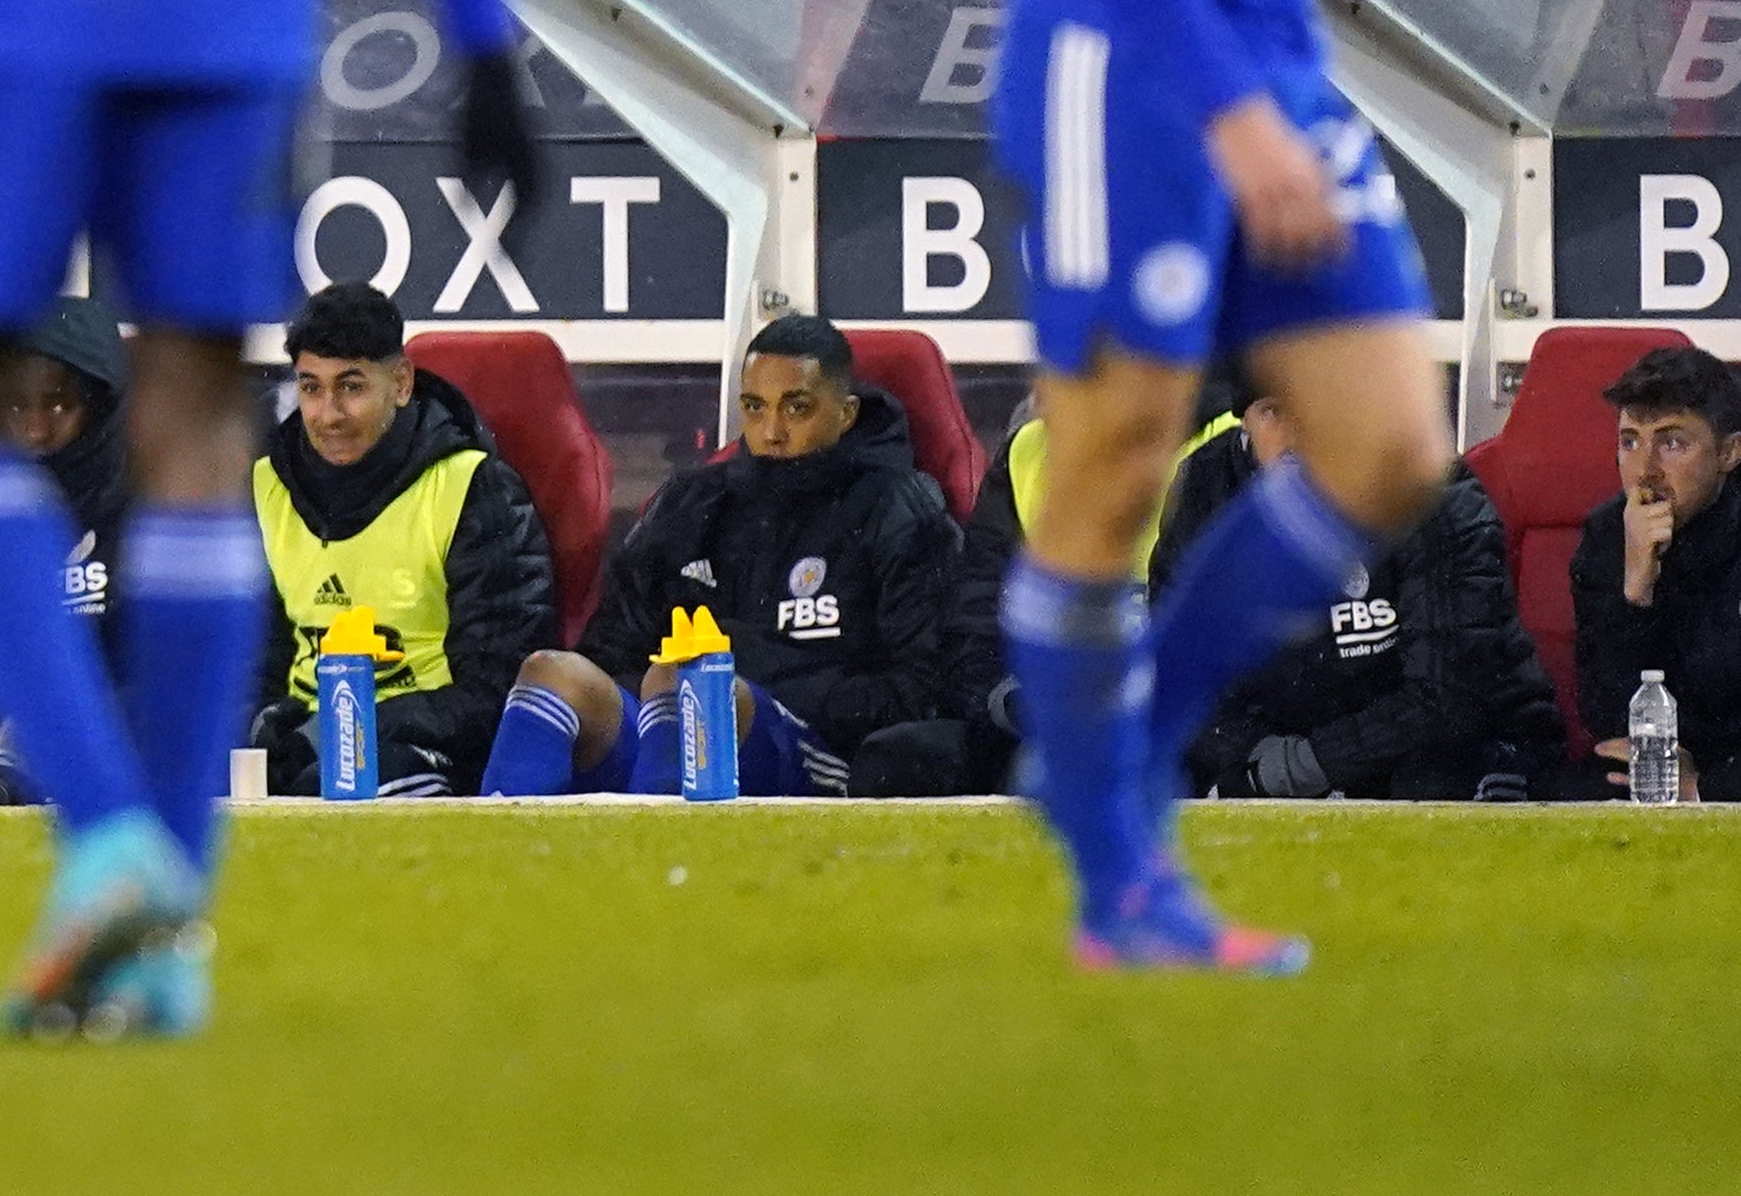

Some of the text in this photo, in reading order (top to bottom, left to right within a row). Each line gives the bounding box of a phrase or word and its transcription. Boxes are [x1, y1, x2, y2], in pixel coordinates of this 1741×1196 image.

[294, 175, 660, 313] OXT
[59, 561, 108, 594] BS
[778, 595, 841, 631] FBS
[1331, 599, 1397, 633] FBS
[1340, 644, 1372, 658] trade
[335, 696, 356, 792] Lucozade
[681, 695, 697, 790] Lucozade
